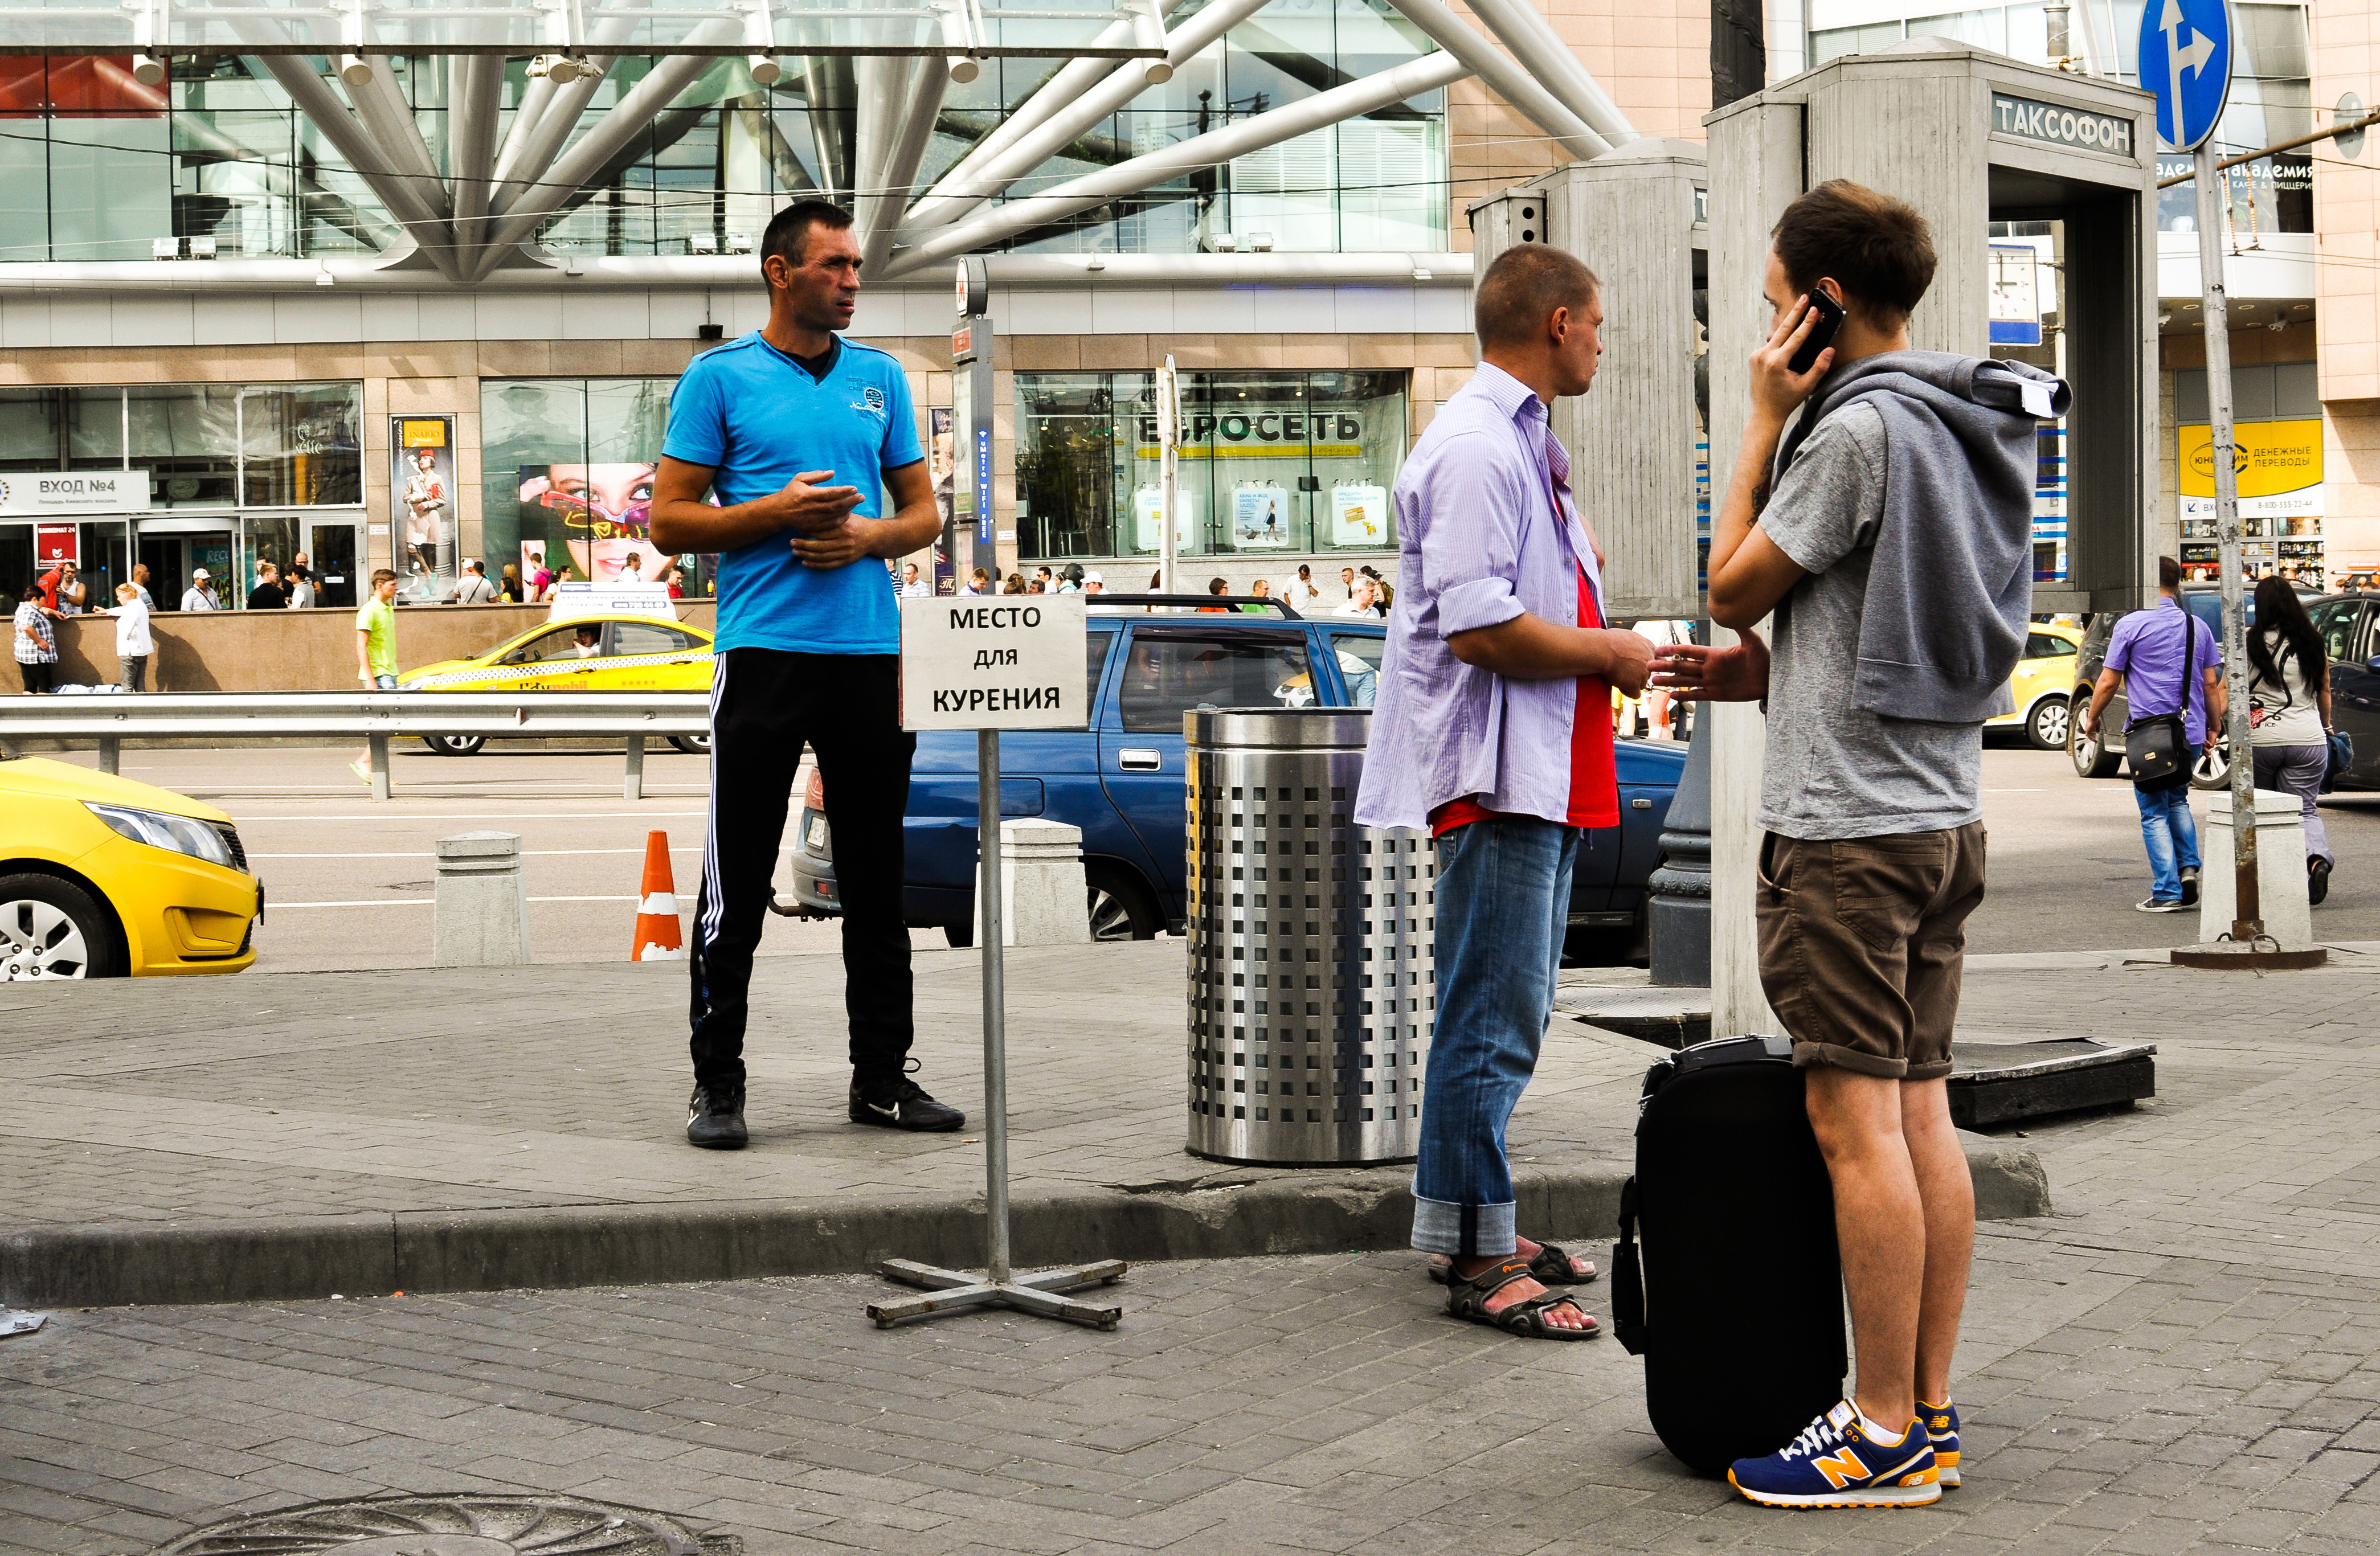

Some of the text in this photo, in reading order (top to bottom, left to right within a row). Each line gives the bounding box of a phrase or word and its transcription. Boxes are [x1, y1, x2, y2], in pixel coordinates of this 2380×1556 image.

[1995, 99, 2130, 152] ТАКСОФОН
[1139, 410, 1361, 443] ЕРОСЕТЬ
[2195, 455, 2248, 465] ЮНИМ
[2254, 446, 2311, 457] ДЕНЕЖНЫЕ
[2255, 457, 2311, 468] ПЕРЕВОДЫ
[40, 480, 116, 494] ВХОД №4
[950, 607, 1041, 629] МЕСТО
[974, 649, 1017, 670] для
[933, 687, 1060, 712] КУРЕНИЯ
[1810, 1446, 1872, 1489] N
